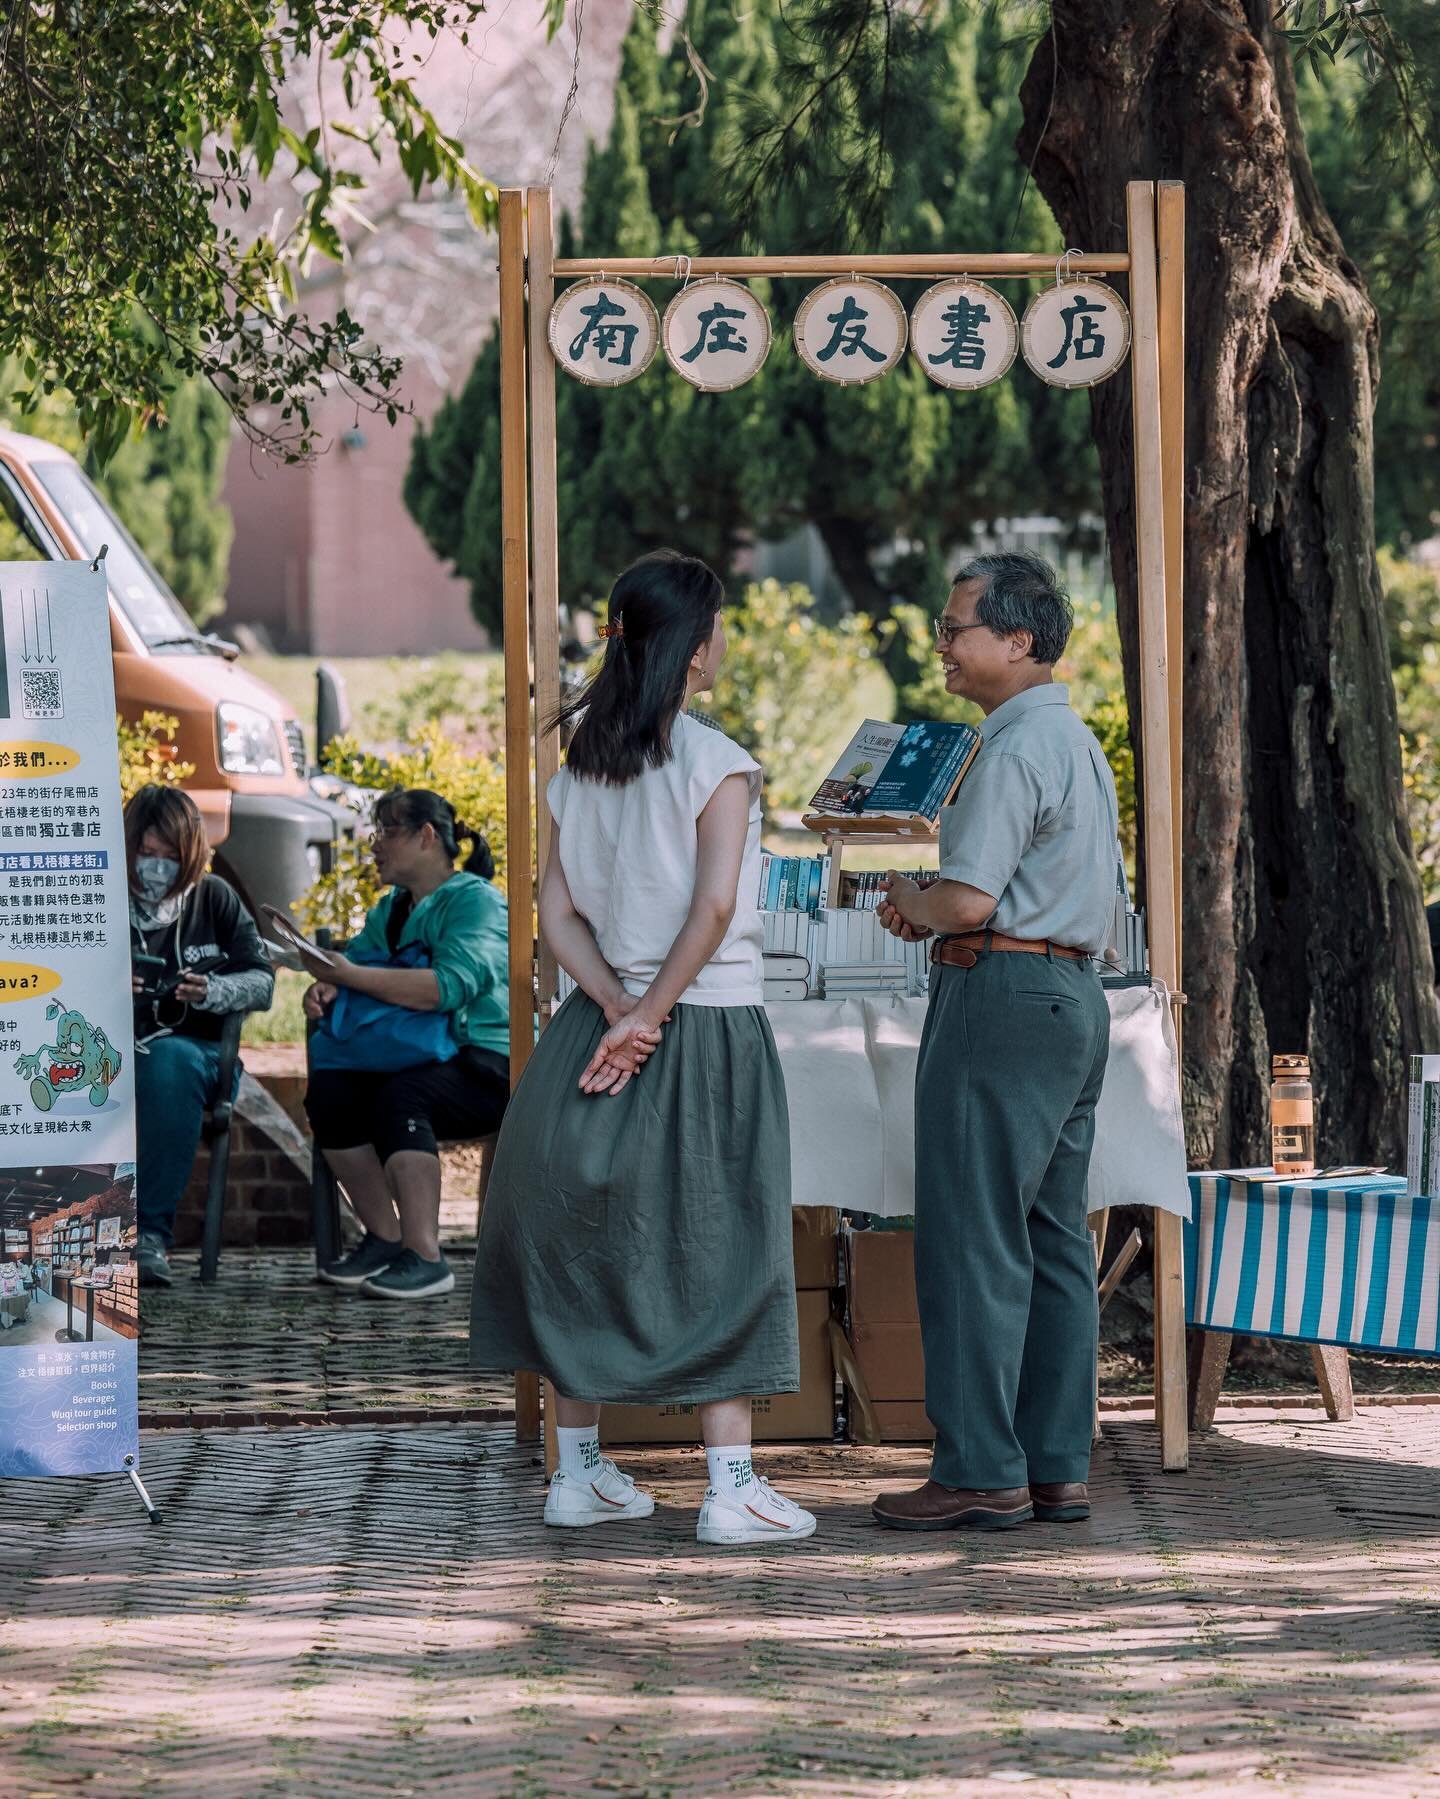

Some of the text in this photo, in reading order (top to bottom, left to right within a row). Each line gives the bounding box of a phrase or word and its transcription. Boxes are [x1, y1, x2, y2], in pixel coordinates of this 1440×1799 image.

[9, 874, 105, 888] 是我們創立的初衷
[91, 1380, 117, 1390] Books
[72, 1395, 115, 1405] Beverages
[51, 1407, 117, 1420] Wuqi tour guide
[57, 1421, 117, 1432] Selection shop
